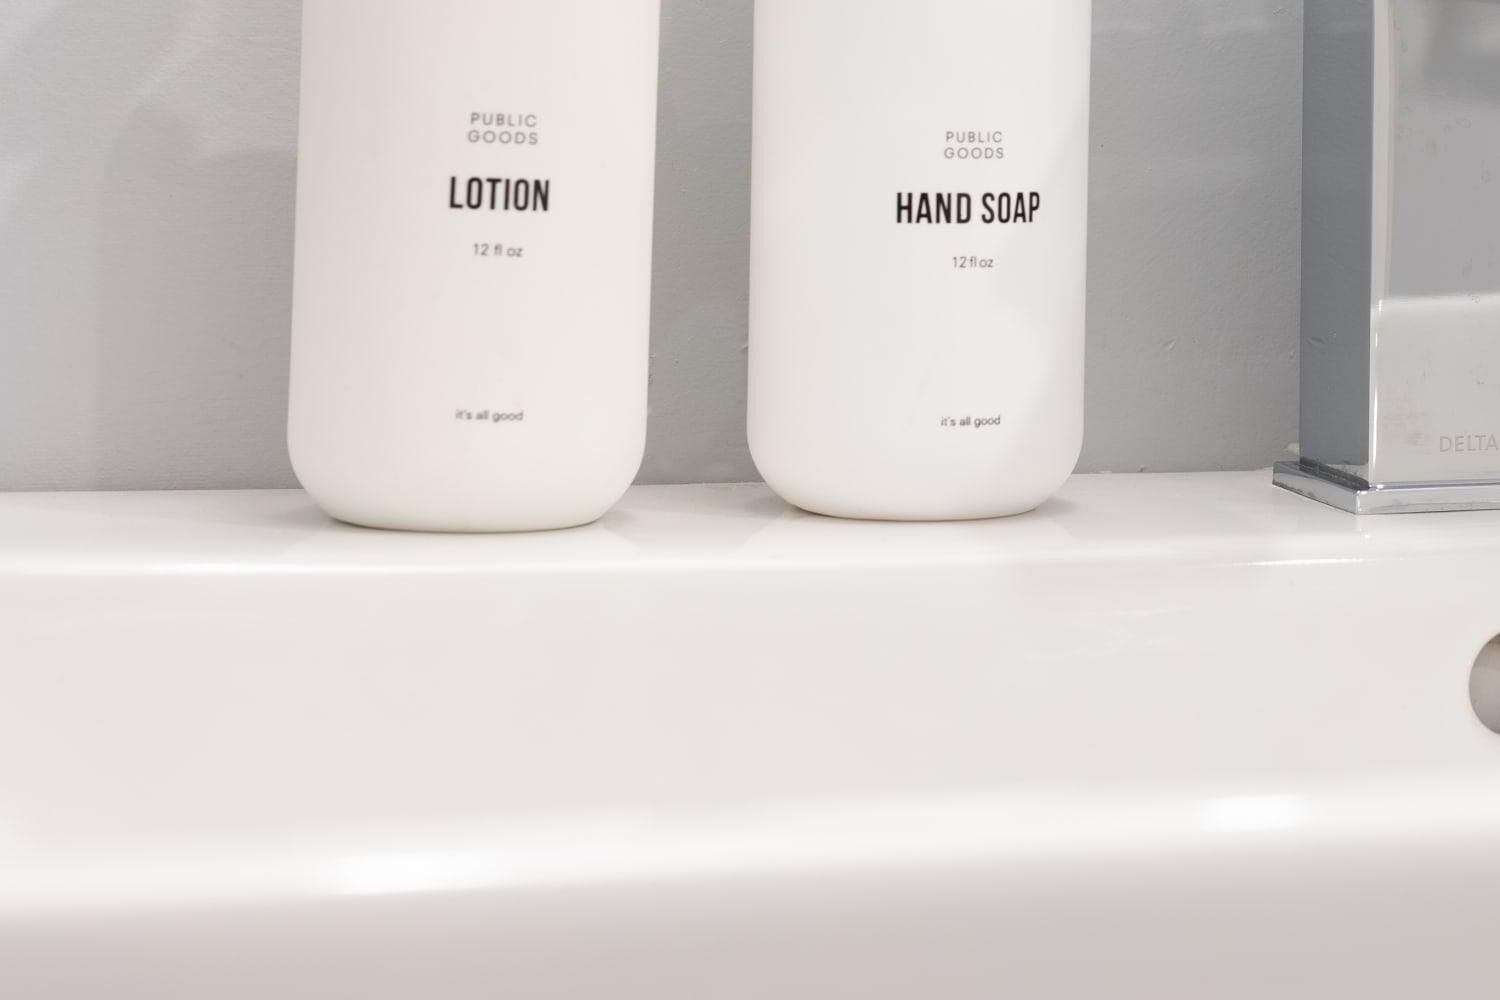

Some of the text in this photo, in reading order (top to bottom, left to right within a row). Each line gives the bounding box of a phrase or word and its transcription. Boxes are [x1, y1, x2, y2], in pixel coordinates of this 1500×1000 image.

[469, 111, 537, 127] PUBLIC
[467, 130, 538, 145] GOODS
[946, 131, 1003, 143] PUBLIC
[944, 147, 1004, 159] GOODS
[449, 176, 549, 211] LOTION
[896, 192, 1040, 224] HAND SOAP
[473, 243, 523, 257] 12 fl oz
[953, 256, 994, 268] 12 fl oz
[476, 409, 489, 421] all
[493, 410, 523, 423] good
[959, 415, 972, 427] all
[974, 415, 1001, 428] good
[1440, 434, 1500, 453] DELTA
